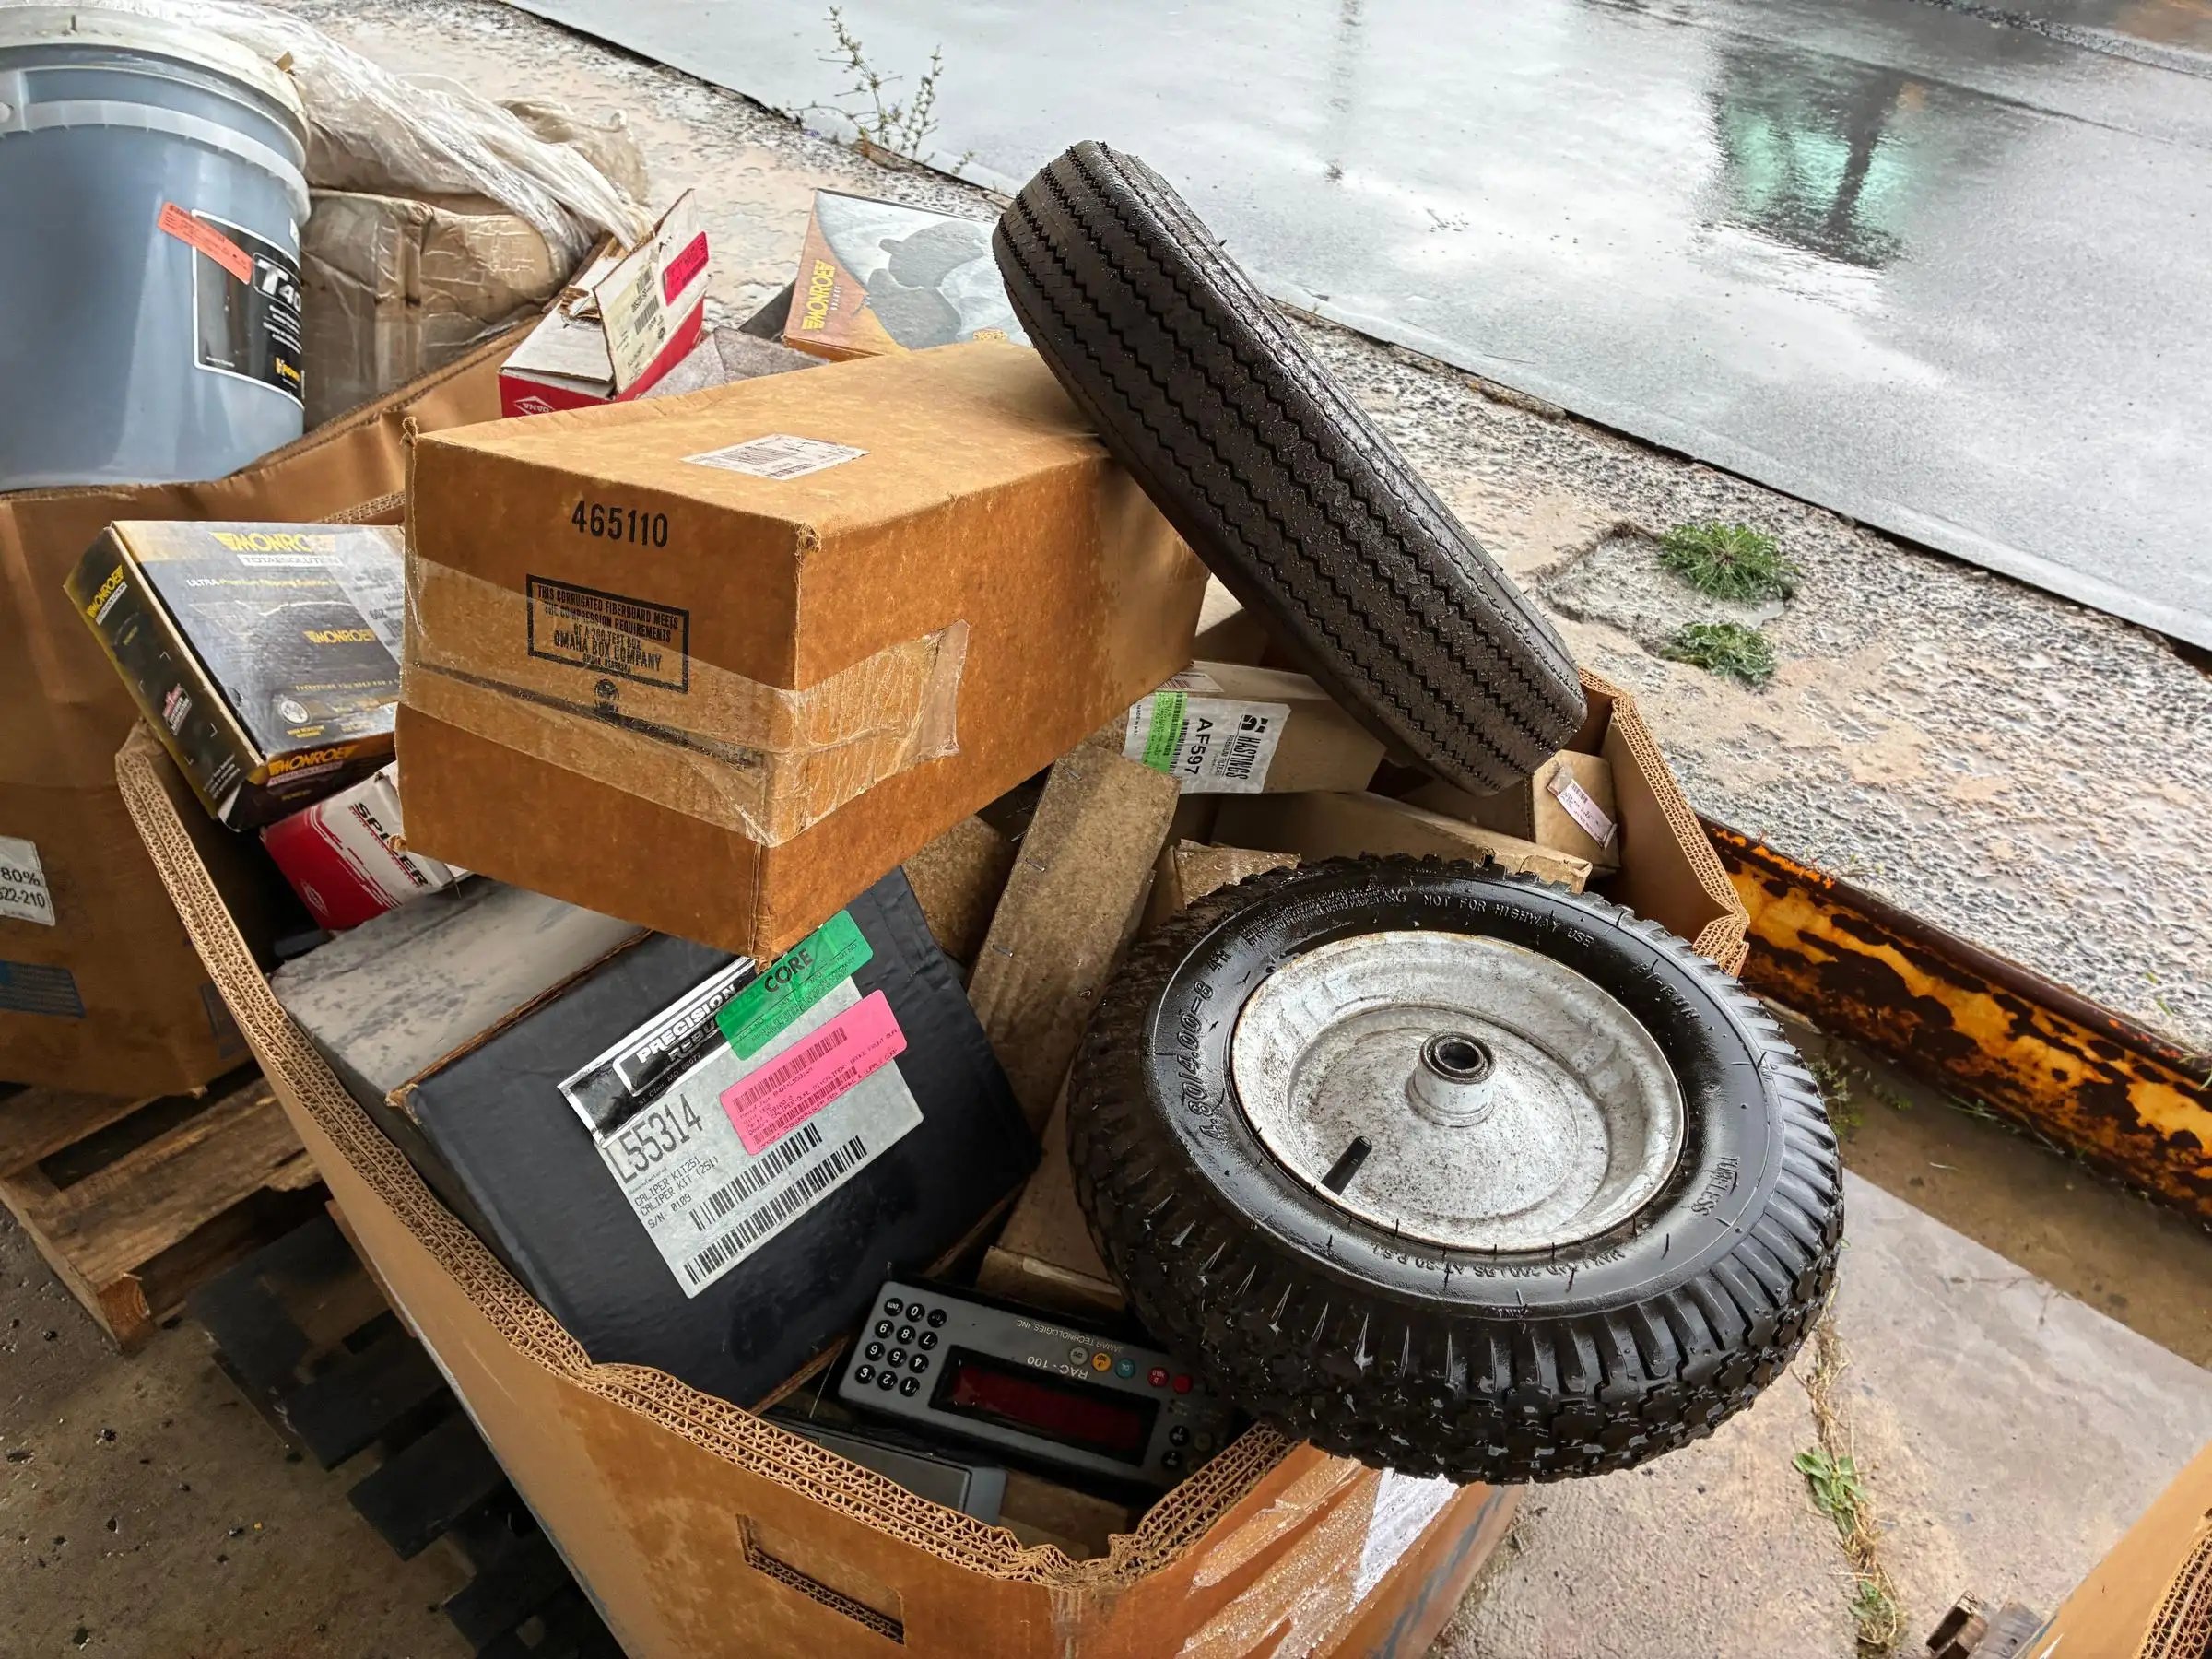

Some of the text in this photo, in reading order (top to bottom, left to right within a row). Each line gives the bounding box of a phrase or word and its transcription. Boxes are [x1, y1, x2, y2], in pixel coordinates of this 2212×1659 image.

[801, 259, 835, 329] MONROE
[522, 402, 548, 412] DANA
[571, 500, 668, 547] 465110
[85, 564, 123, 618] MONROE
[538, 585, 678, 629] THIS CORRUGATED FIBERBOARD MEETS
[303, 629, 376, 643] MONROE
[560, 606, 612, 628] COMPRESSION
[615, 618, 671, 642] REQUIREMENTS
[592, 640, 610, 658] BOX
[612, 644, 661, 671] COMPANY
[608, 633, 625, 645] TEST
[627, 638, 641, 649] BOX
[267, 744, 359, 775] MONROE
[1184, 717, 1214, 774] AF597
[1220, 734, 1233, 757] PREMIUM
[1225, 734, 1261, 782] HASTINGS
[354, 800, 428, 887] SPIER
[1423, 896, 1594, 947] NOT FOR HIGHWAY USE
[761, 947, 813, 994] CORE
[636, 984, 736, 1063] PRECISION
[603, 1092, 706, 1184] L55314
[633, 1155, 700, 1206] CALIPER KIT251
[639, 1155, 720, 1217] CALIPER KIT (251)
[646, 1211, 665, 1229] S/N
[910, 1305, 919, 1316] 0
[878, 1322, 930, 1344] 7 8 9
[1095, 1339, 1124, 1353] JAMAR
[869, 1344, 922, 1368] 4 5 6
[1025, 1354, 1049, 1369] 100
[1057, 1362, 1088, 1380] RAC
[859, 1366, 912, 1391] 1 2 3
